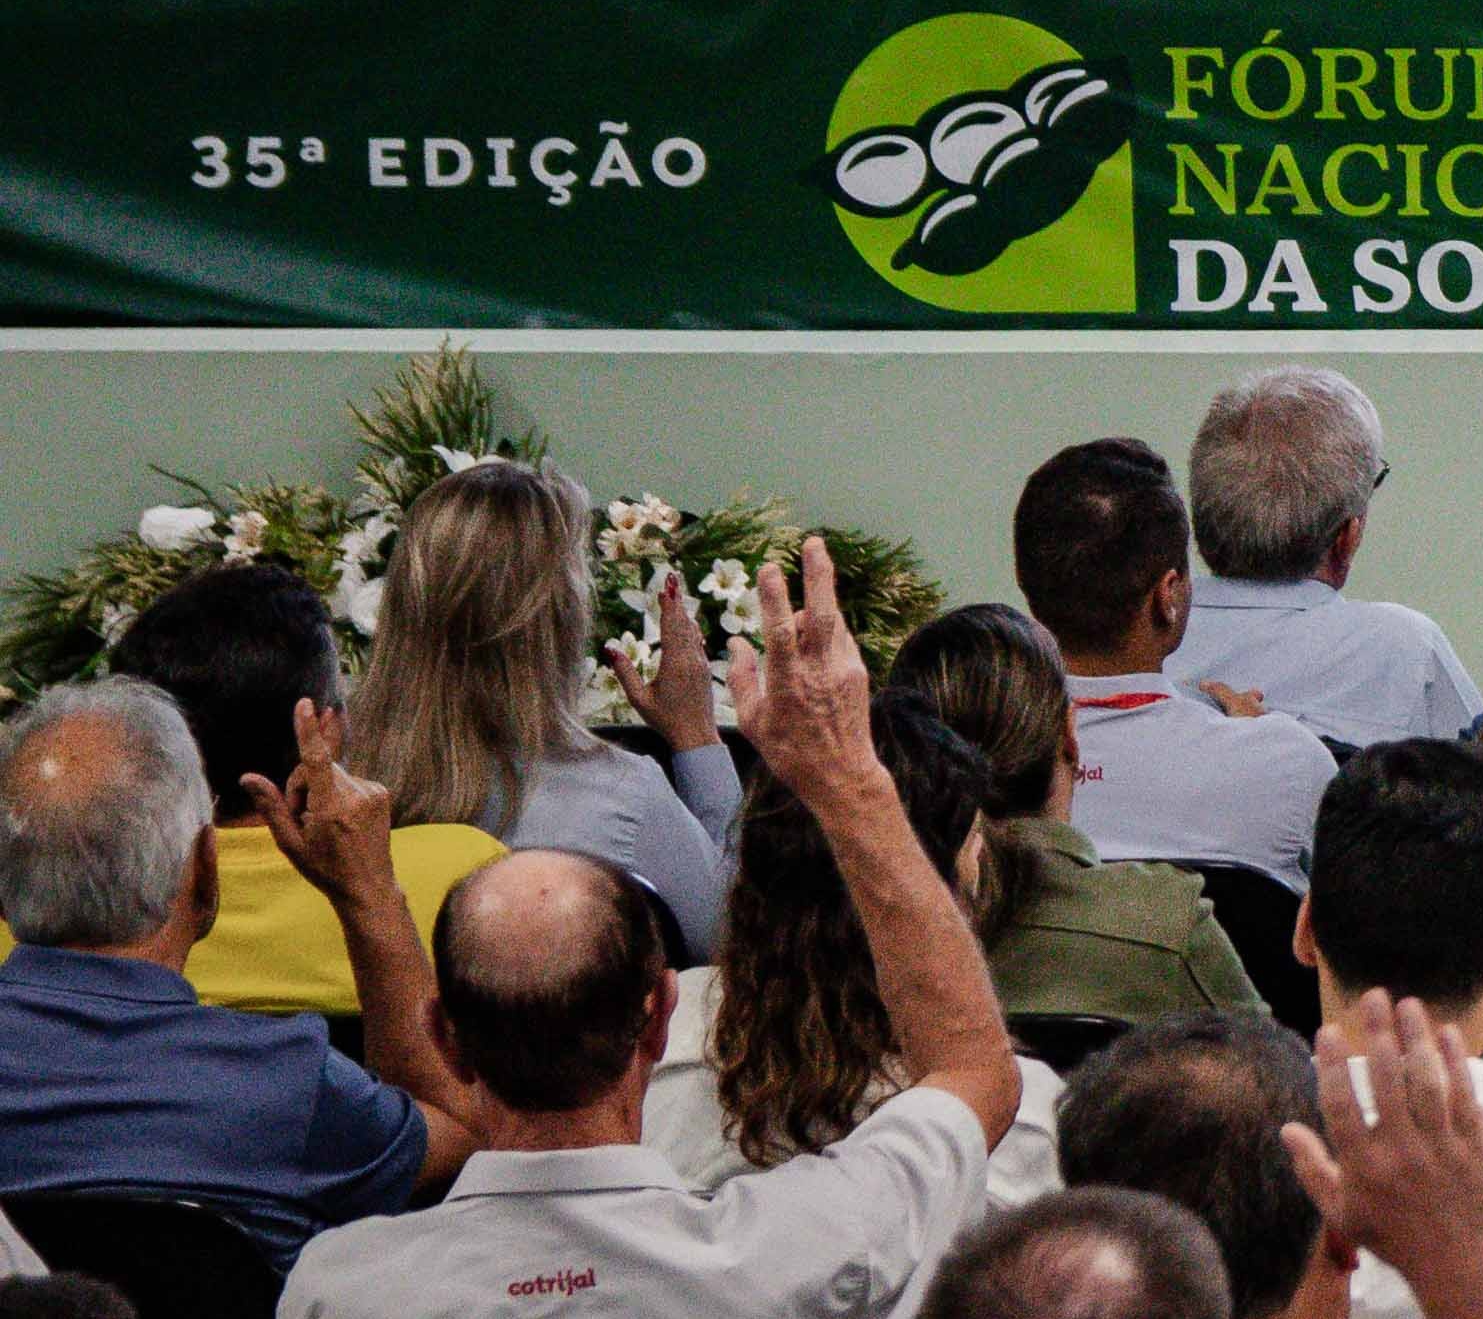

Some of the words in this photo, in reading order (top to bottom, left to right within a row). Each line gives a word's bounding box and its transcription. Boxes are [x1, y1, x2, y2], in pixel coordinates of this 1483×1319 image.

[370, 122, 705, 204] EDIÇÃO
[1170, 240, 1327, 311] DA
[507, 1267, 597, 1297] cotrijal
